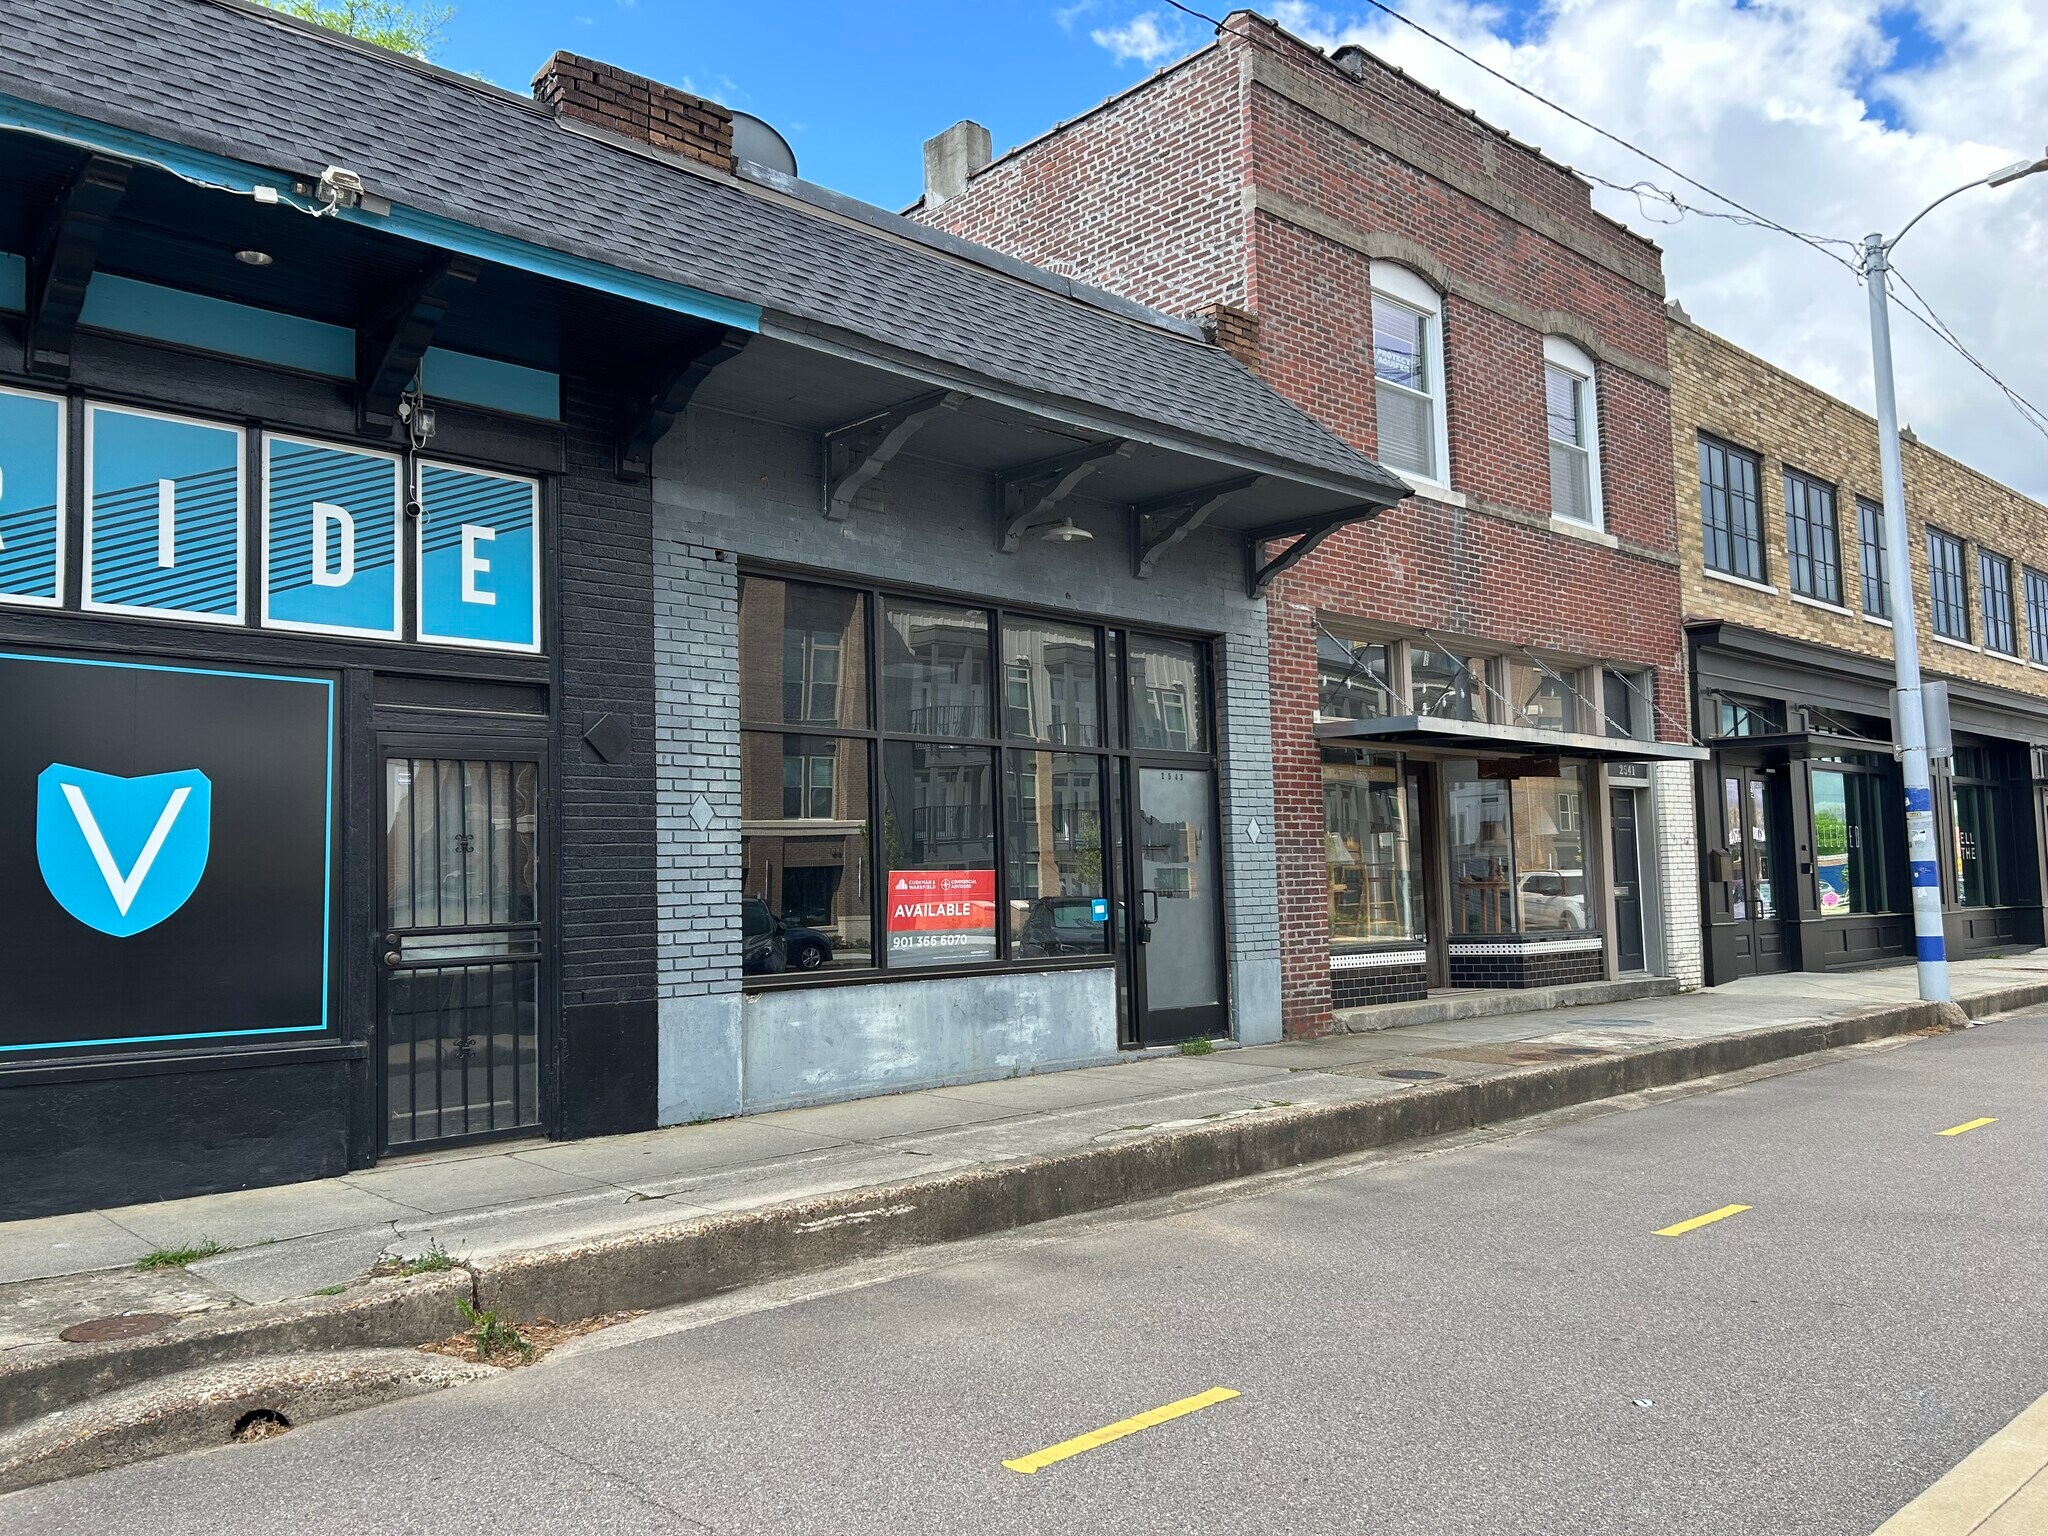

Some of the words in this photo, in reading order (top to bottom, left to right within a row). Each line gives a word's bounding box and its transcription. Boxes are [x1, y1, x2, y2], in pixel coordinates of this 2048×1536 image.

[1377, 349, 1411, 366] PROTECT
[1377, 356, 1410, 373] AQUIFER
[0, 465, 497, 606] IDE
[1618, 764, 1636, 776] 2541
[60, 782, 193, 917] V
[894, 903, 971, 918] AVAILABLE
[893, 936, 913, 948] 901
[916, 935, 938, 947] 366
[940, 934, 968, 946] 6070
